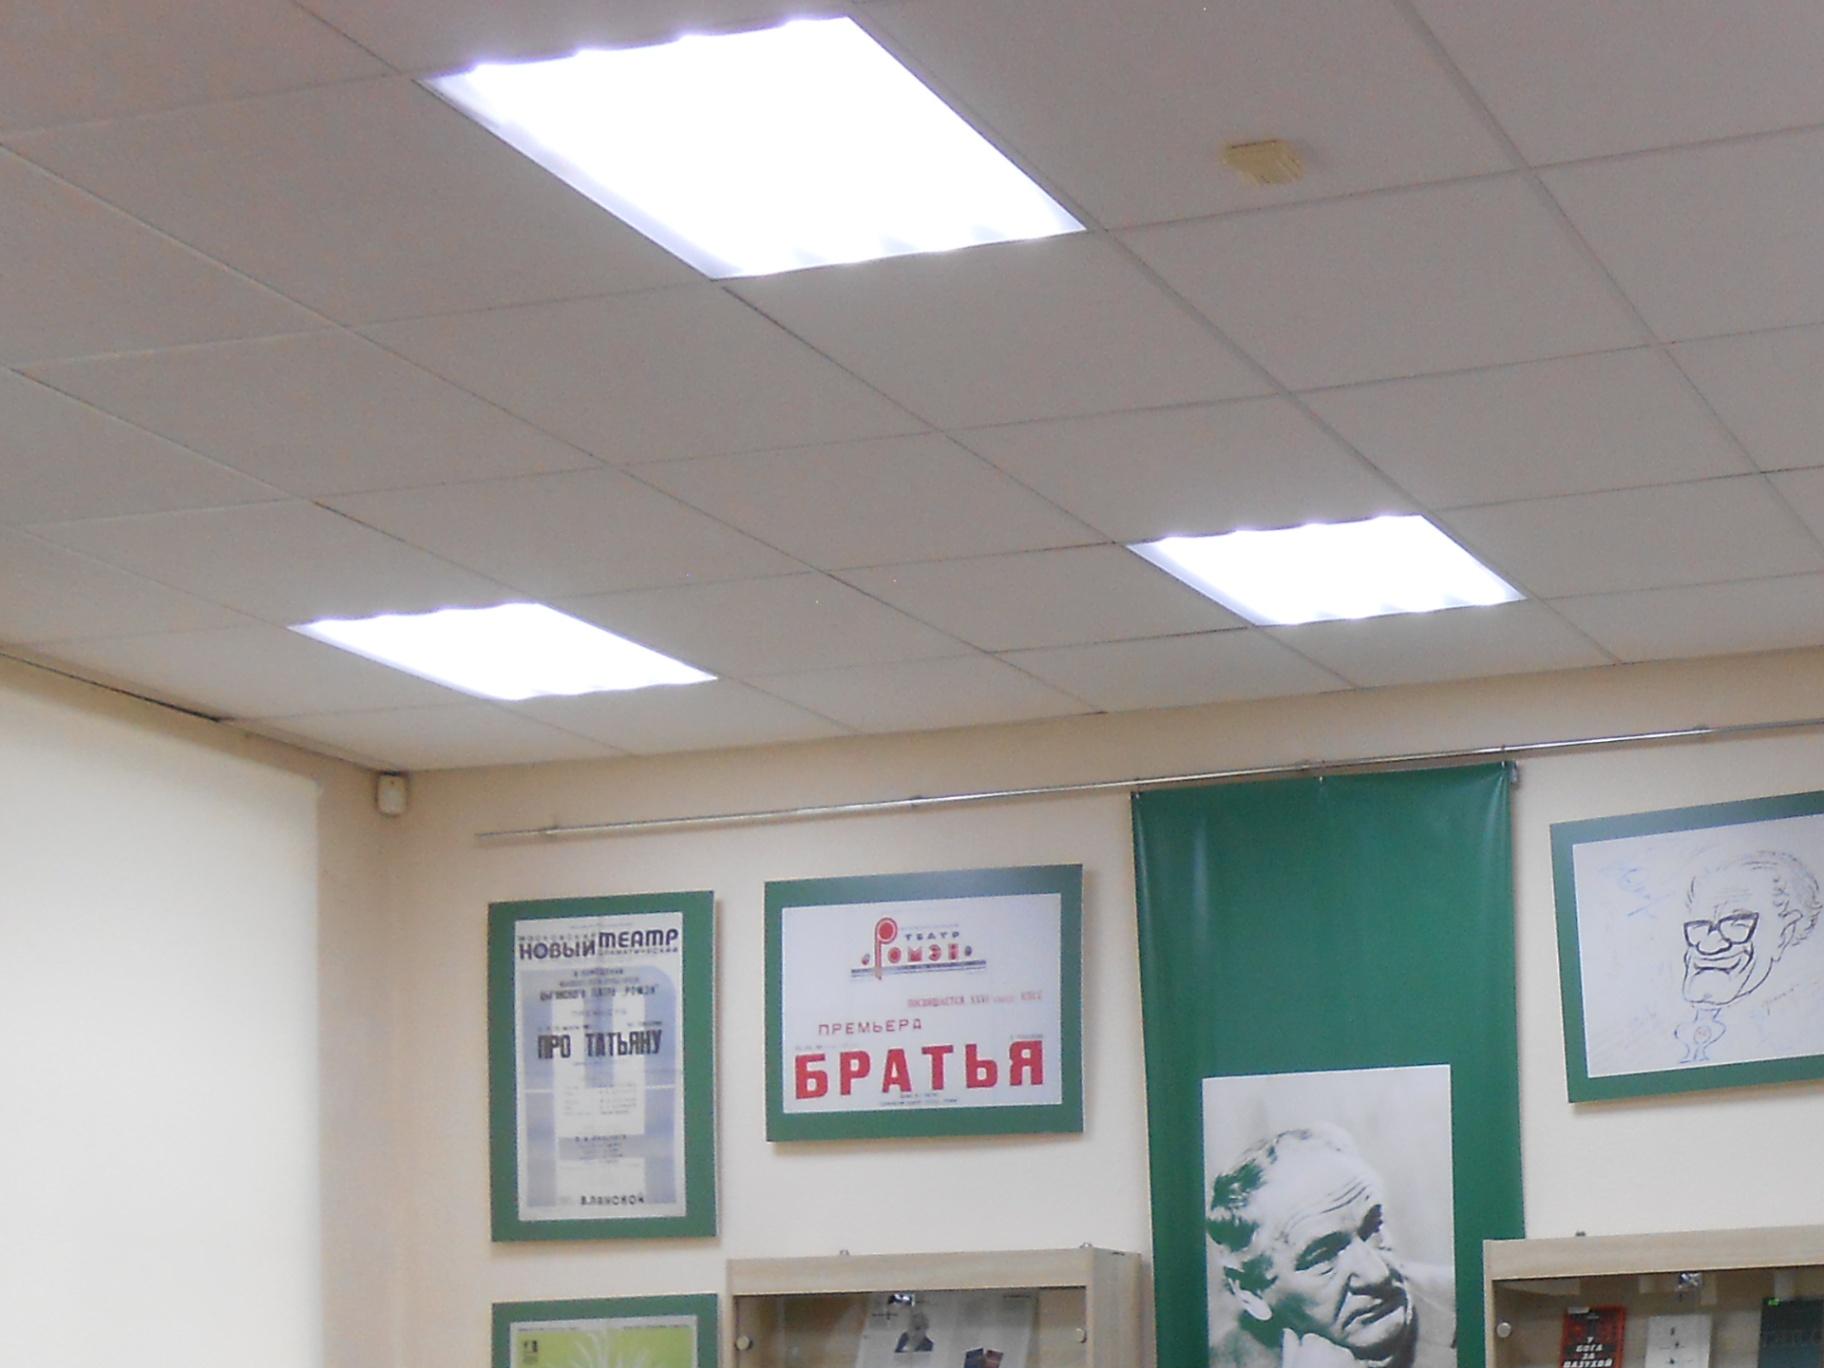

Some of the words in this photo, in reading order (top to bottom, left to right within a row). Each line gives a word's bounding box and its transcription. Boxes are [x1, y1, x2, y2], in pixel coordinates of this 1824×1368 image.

[518, 940, 596, 960] НОВЫЙ
[599, 928, 680, 948] ТЕАТР
[905, 930, 961, 942] ТЕАТР
[818, 1017, 923, 1036] ПРЕМЬЕРА
[536, 1034, 571, 1060] ПРО
[585, 1029, 662, 1058] ТАТЬЯНУ
[794, 1039, 1044, 1100] БРАТЬЯ
